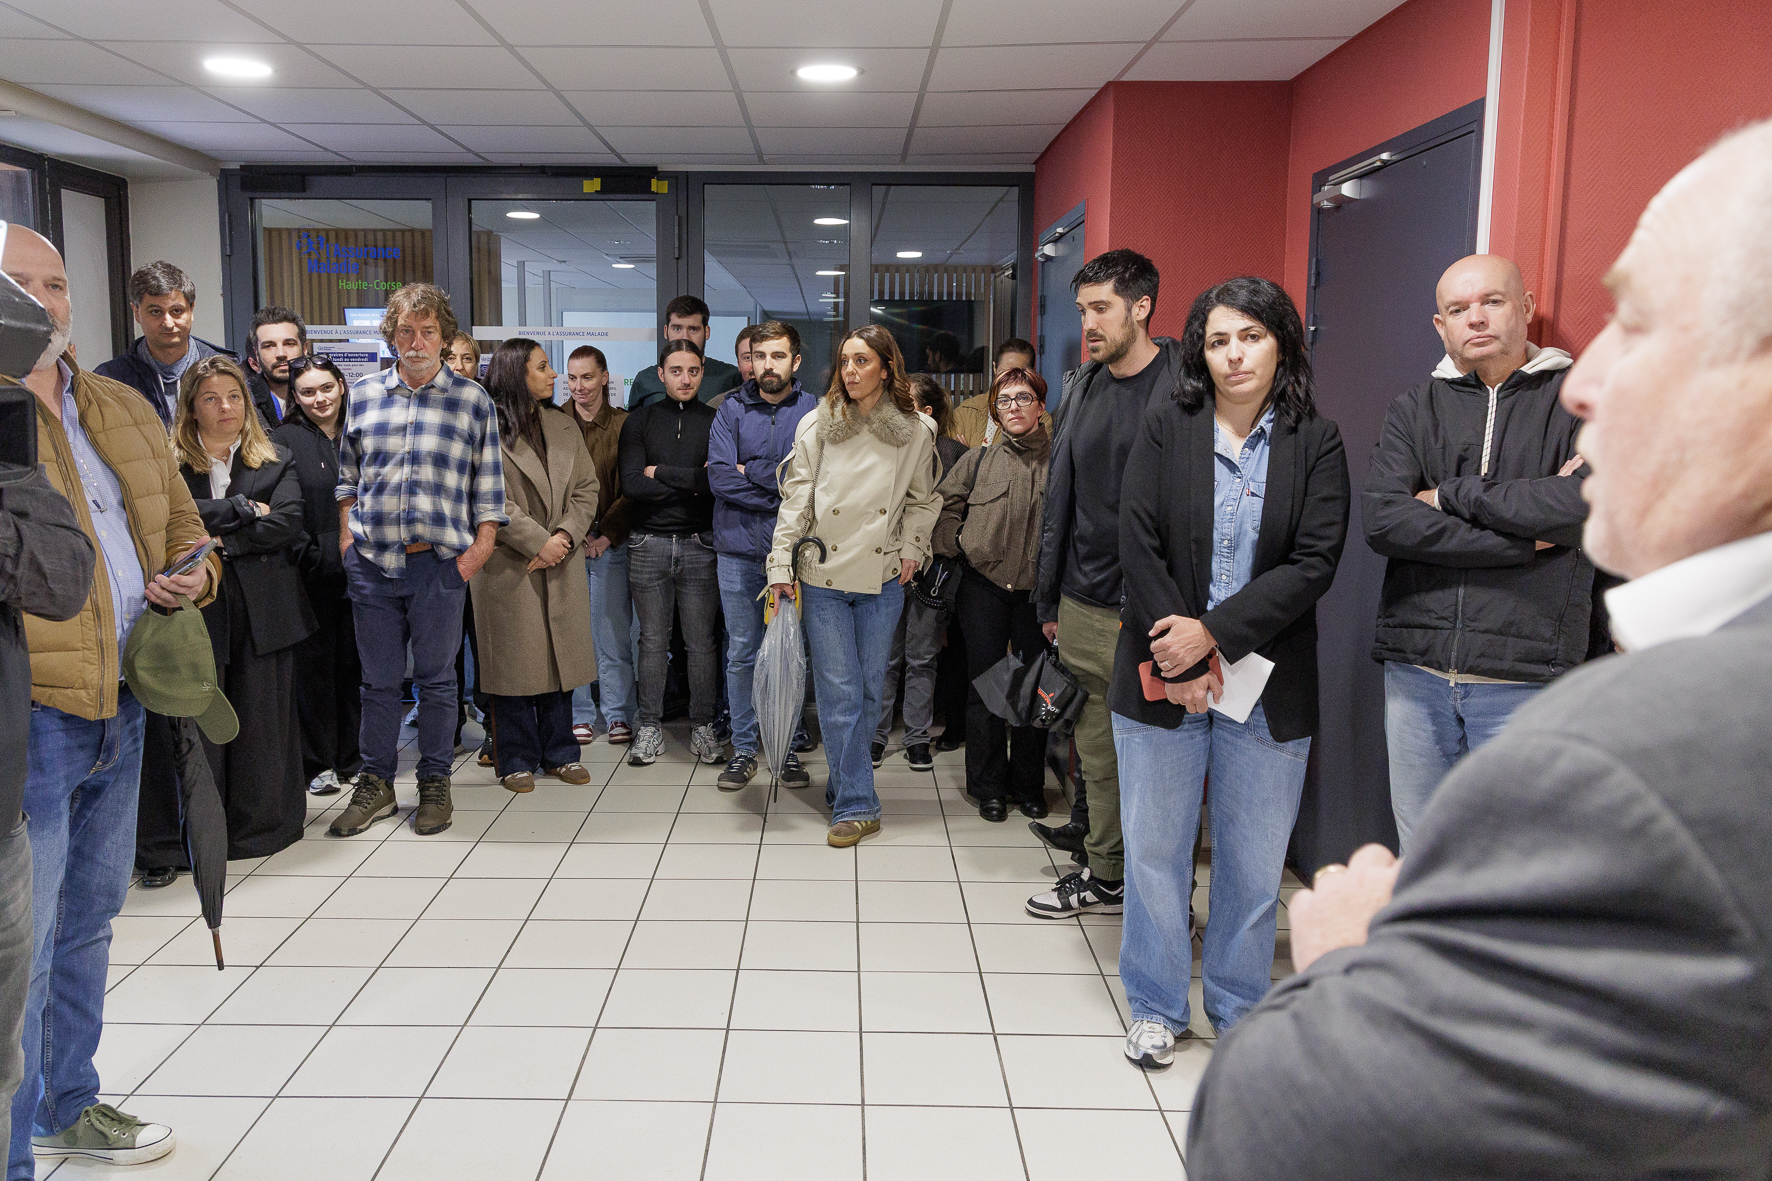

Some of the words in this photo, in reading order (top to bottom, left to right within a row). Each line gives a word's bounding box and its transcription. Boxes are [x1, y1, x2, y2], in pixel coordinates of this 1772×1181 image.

[326, 243, 401, 259] l'Assurance
[307, 258, 360, 274] Maladie
[338, 279, 402, 290] Haute-Corse
